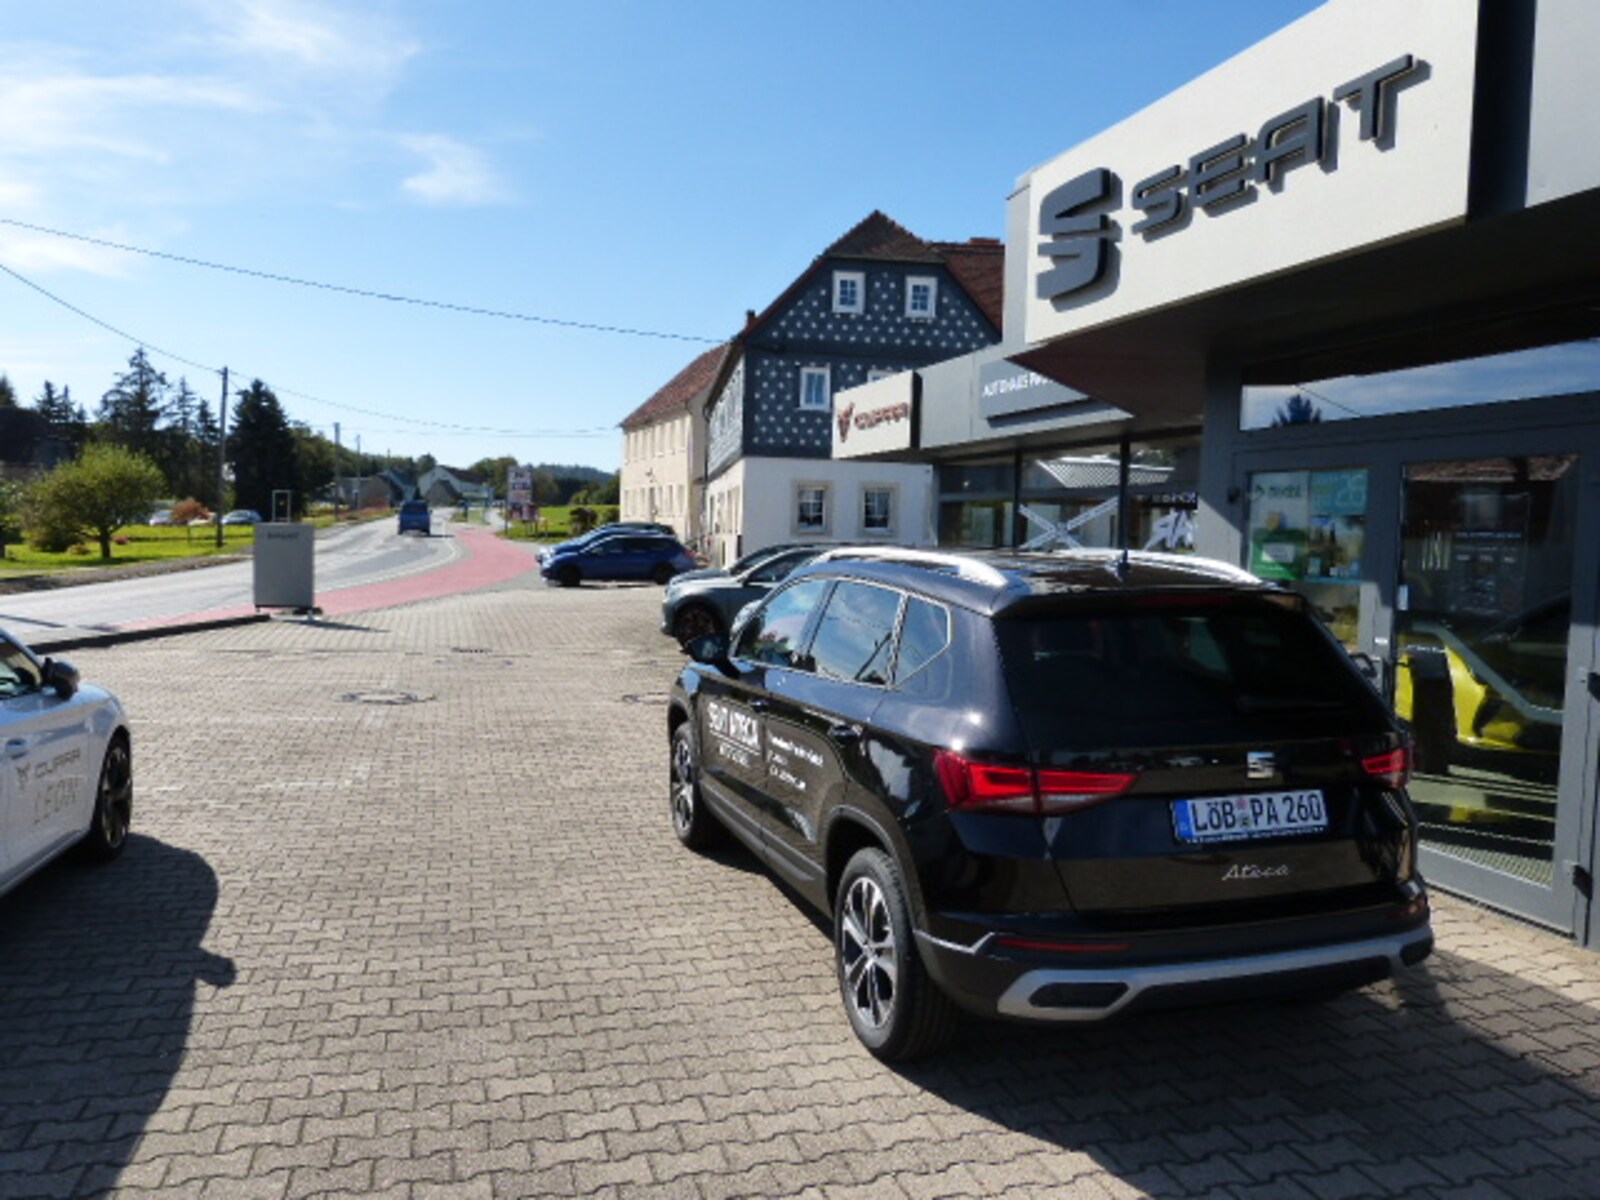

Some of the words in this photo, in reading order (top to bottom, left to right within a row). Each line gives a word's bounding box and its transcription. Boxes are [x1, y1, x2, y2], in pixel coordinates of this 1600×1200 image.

[1131, 53, 1420, 236] SEAT
[855, 403, 908, 430] CUPRA
[34, 748, 80, 778] CUPRA
[1251, 797, 1280, 827] PA
[1282, 794, 1322, 824] 260
